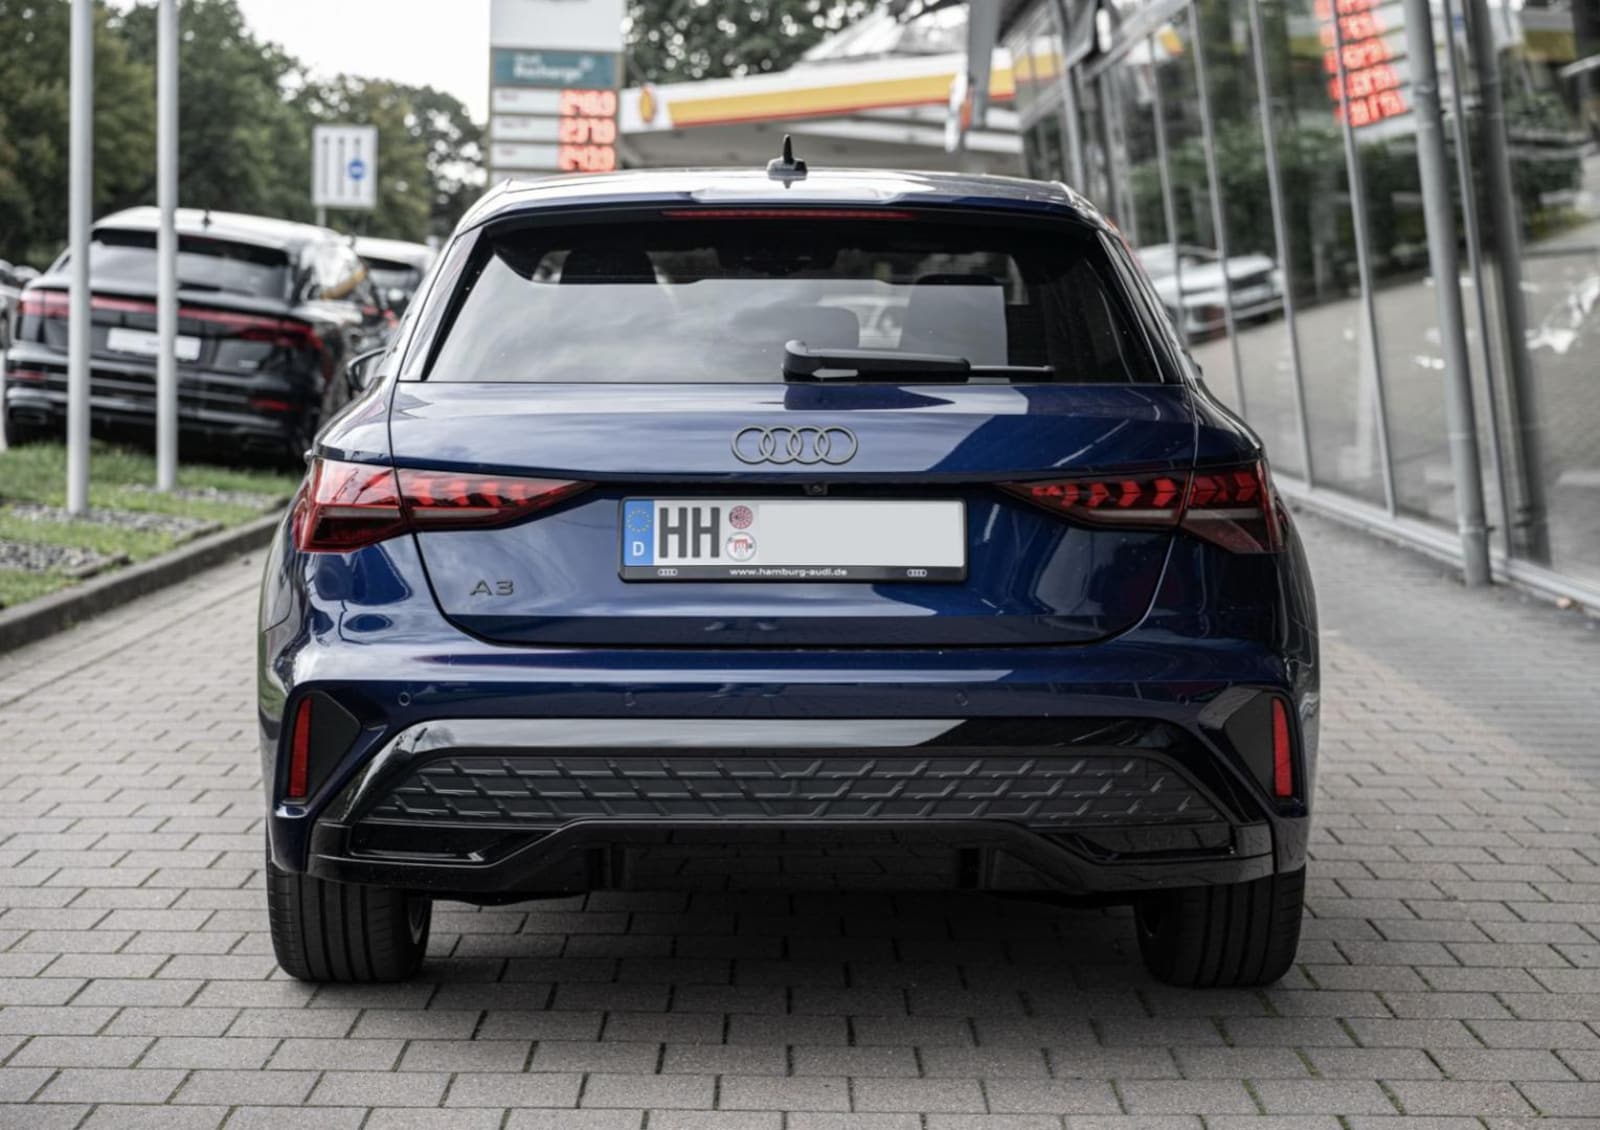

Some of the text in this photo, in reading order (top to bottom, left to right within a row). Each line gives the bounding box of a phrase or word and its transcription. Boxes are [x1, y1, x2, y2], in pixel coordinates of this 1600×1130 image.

[658, 506, 721, 559] HH
[632, 541, 645, 557] D
[729, 567, 848, 578] www.hamburg-audi.de
[469, 579, 514, 596] A3
